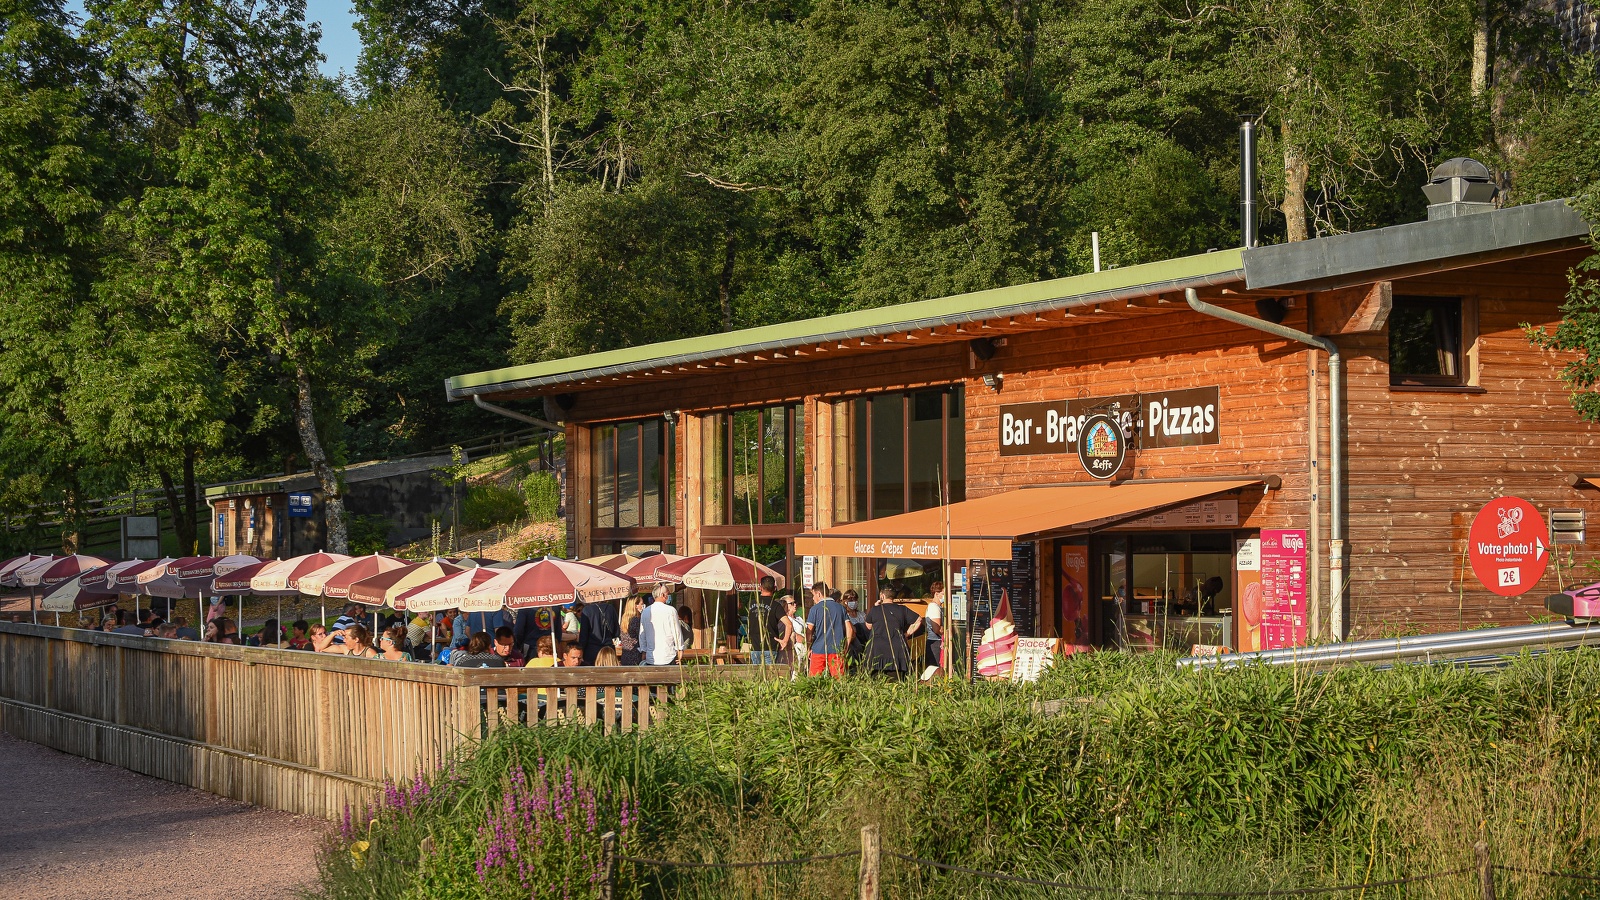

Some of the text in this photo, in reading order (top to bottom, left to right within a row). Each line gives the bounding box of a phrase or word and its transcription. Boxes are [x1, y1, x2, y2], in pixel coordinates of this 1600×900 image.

[1003, 412, 1032, 446] Bar
[1149, 397, 1215, 437] Pizzas
[1092, 459, 1113, 471] Leffe
[854, 540, 939, 557] Glaces Crêpes Gaufres
[1478, 542, 1502, 555] Votre
[1503, 570, 1516, 583] 2€
[508, 593, 574, 606] L'ARTISAN DES SAVEURS
